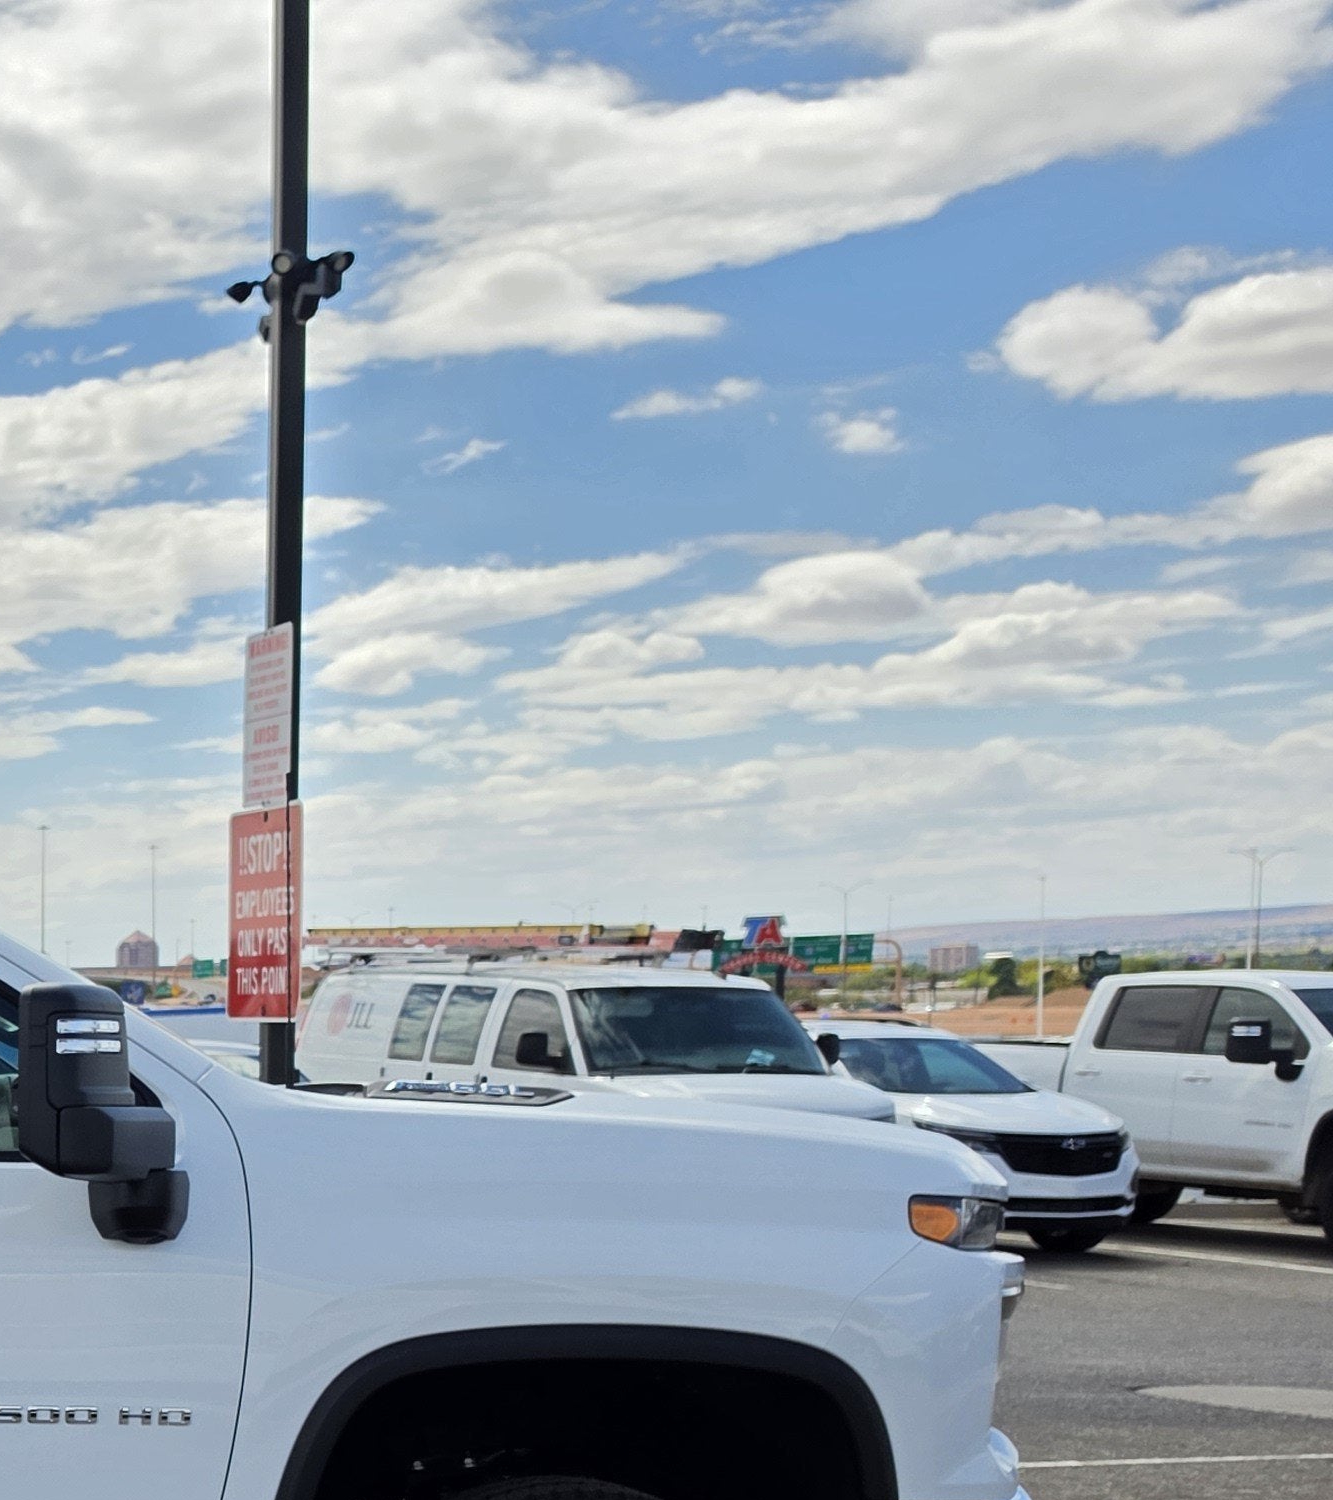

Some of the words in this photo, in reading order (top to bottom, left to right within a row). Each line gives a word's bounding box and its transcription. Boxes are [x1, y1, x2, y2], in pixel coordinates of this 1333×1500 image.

[235, 886, 295, 920] EMPLOYEES
[237, 927, 264, 958] ONLY
[267, 926, 290, 956] PAS
[742, 916, 784, 948] TA
[236, 966, 259, 997] THIS
[346, 1002, 375, 1030] JLL
[118, 1407, 192, 1426] HD
